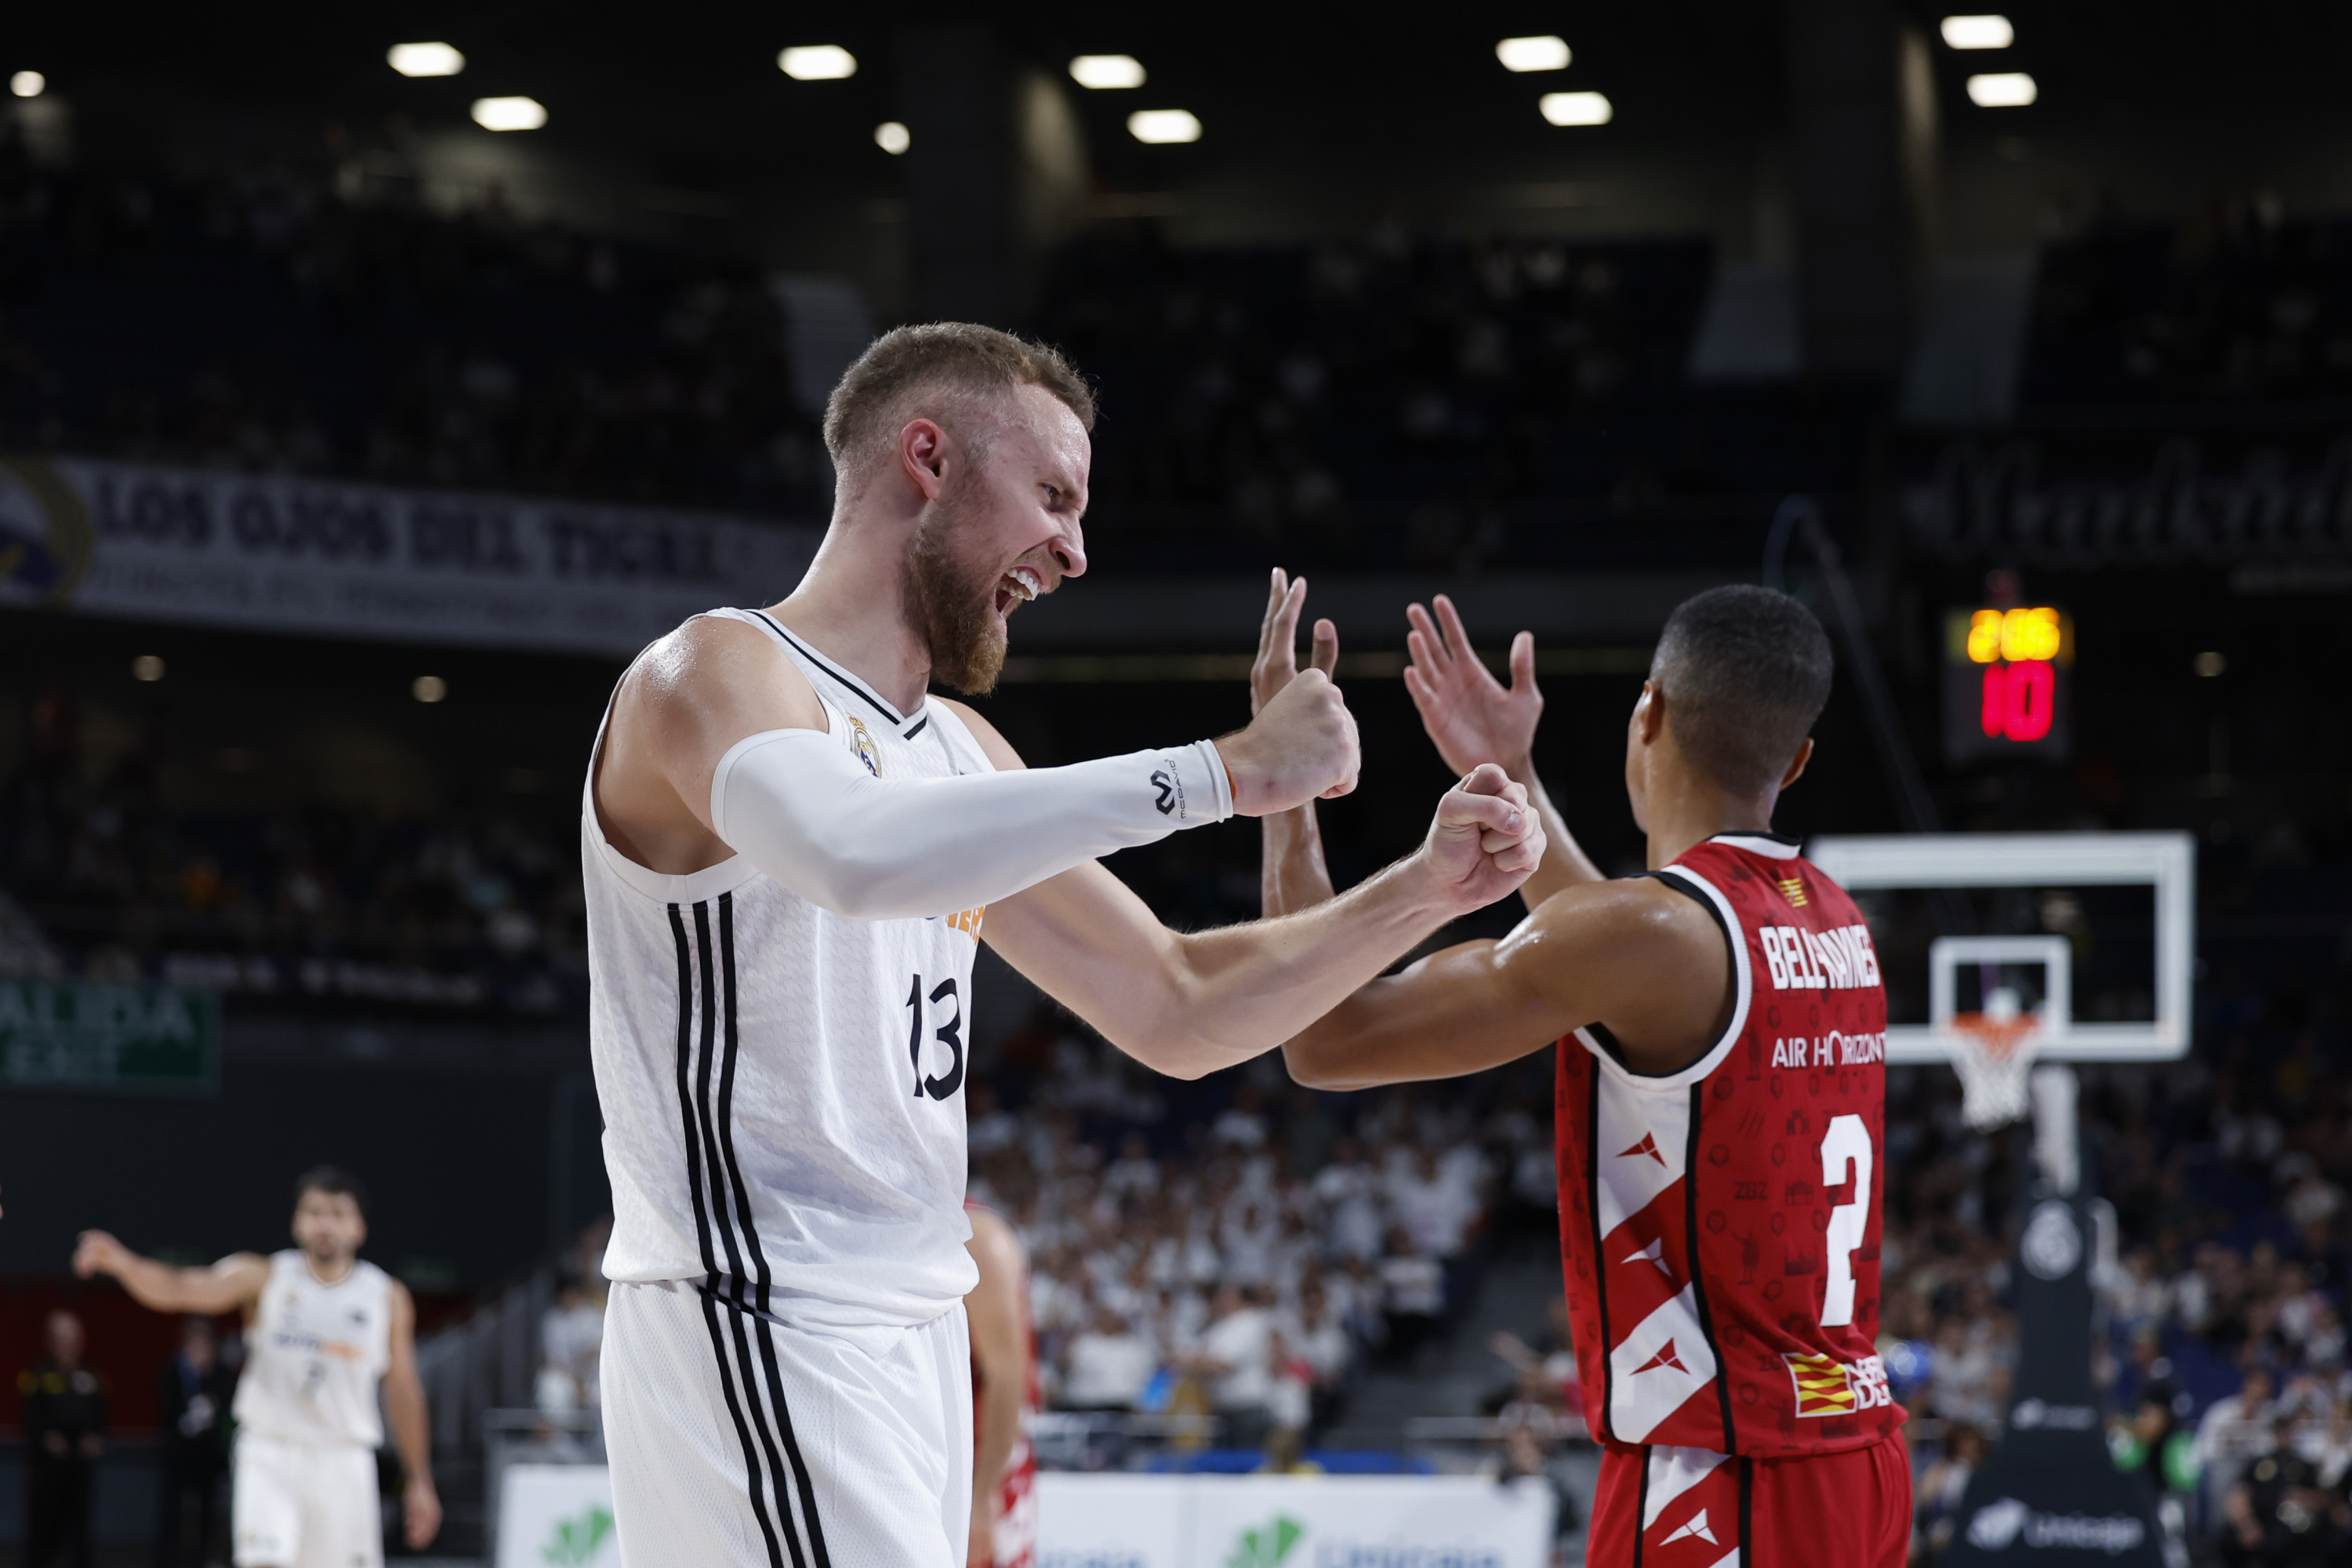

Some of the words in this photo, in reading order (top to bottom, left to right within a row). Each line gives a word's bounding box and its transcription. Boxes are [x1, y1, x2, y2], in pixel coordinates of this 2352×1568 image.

[1982, 659, 2055, 741] 10
[906, 973, 964, 1102] 13
[1771, 1037, 1808, 1068] AIR
[1819, 1113, 1873, 1327] 2
